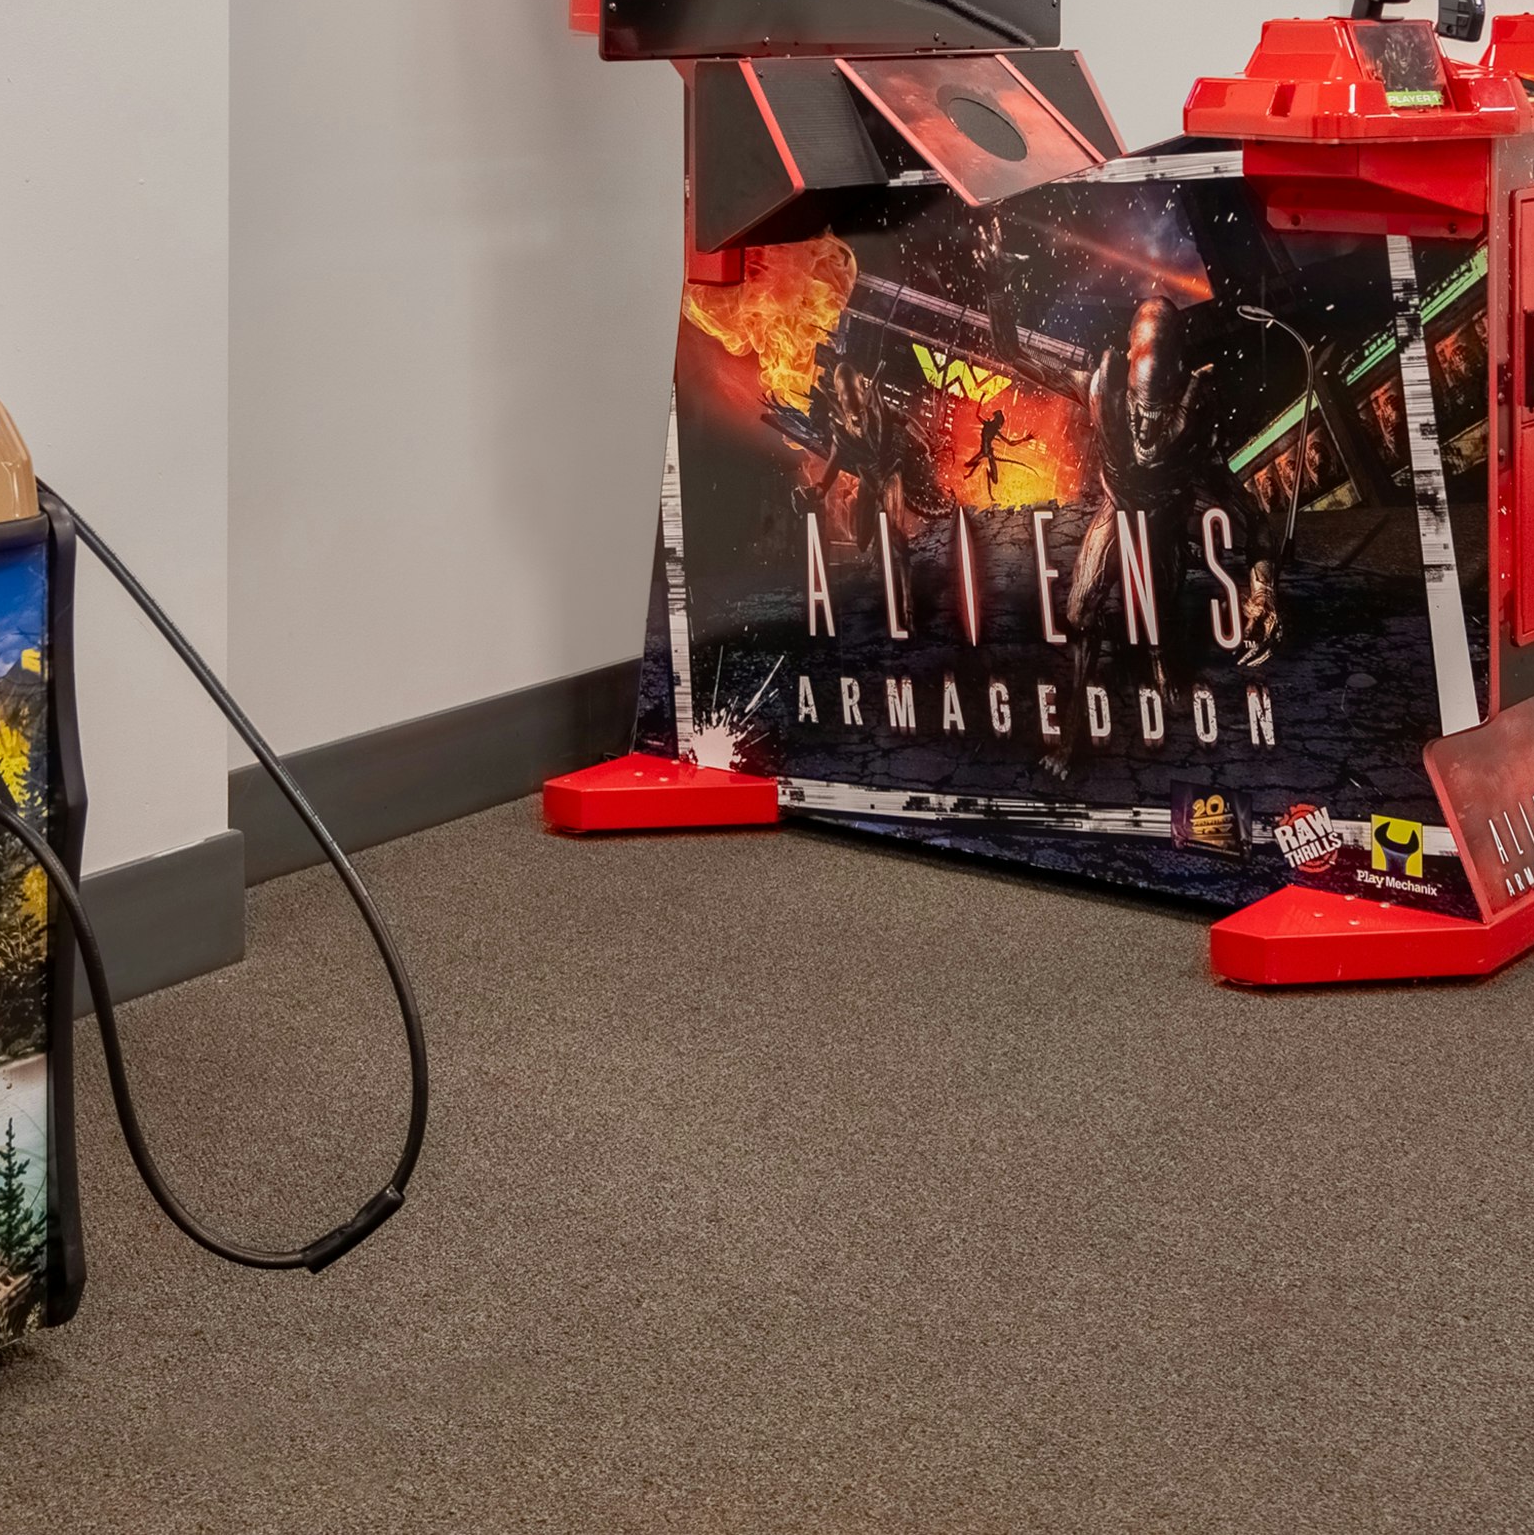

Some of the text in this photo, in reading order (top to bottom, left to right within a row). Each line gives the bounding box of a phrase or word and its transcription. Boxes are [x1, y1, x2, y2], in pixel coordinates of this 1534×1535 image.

[1388, 94, 1440, 104] PLAYER 1
[807, 506, 1242, 650] ALIENS
[798, 675, 1275, 746] ARMAGEDDON
[1274, 806, 1333, 853] RAW
[1284, 831, 1342, 868] THRILLS
[1356, 869, 1438, 896] Play Mechanix
